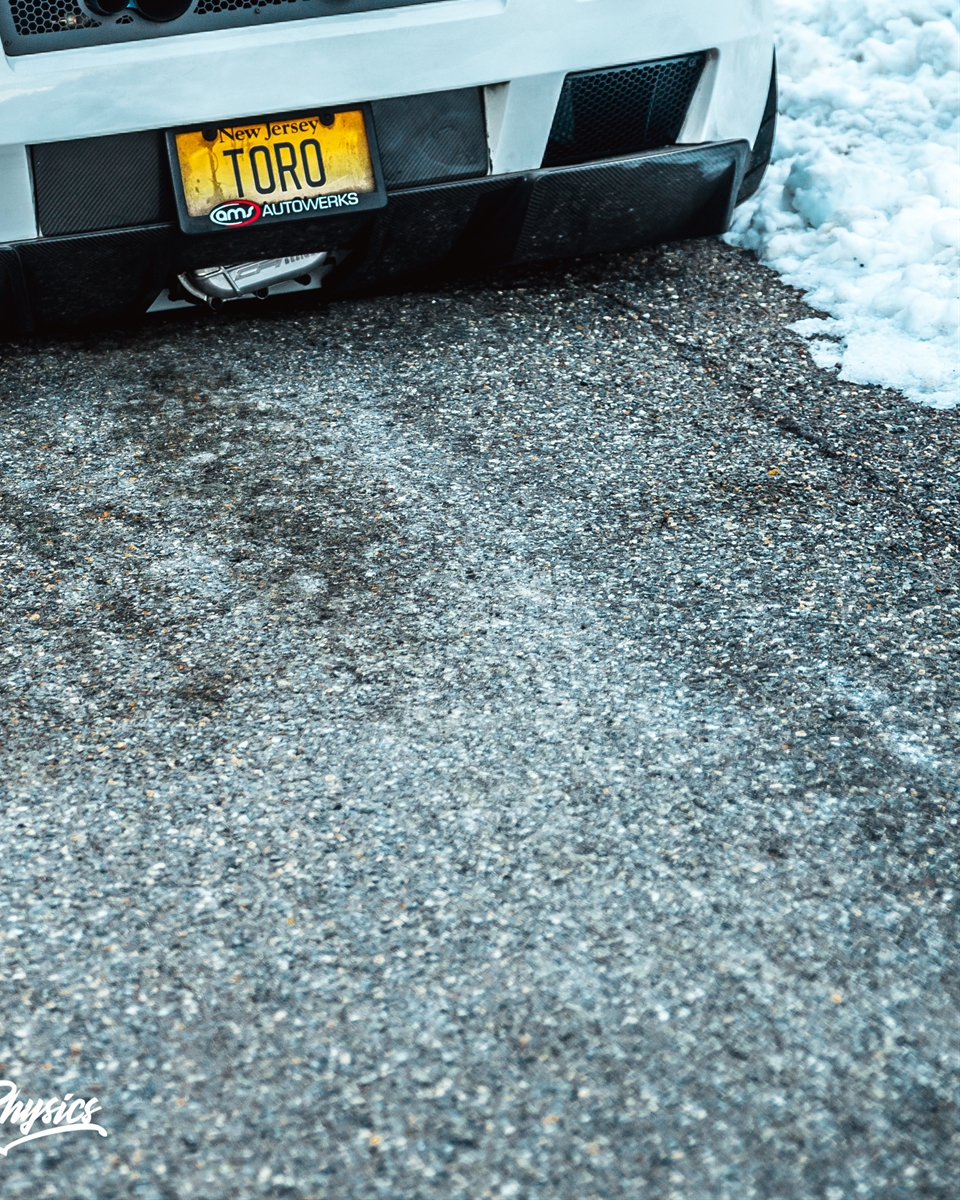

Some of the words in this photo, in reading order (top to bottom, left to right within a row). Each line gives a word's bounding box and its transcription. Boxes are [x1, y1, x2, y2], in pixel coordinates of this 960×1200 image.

[218, 126, 261, 144] New
[265, 118, 320, 140] Jersey
[223, 138, 326, 198] TORO
[262, 192, 359, 217] AUTOWERKS
